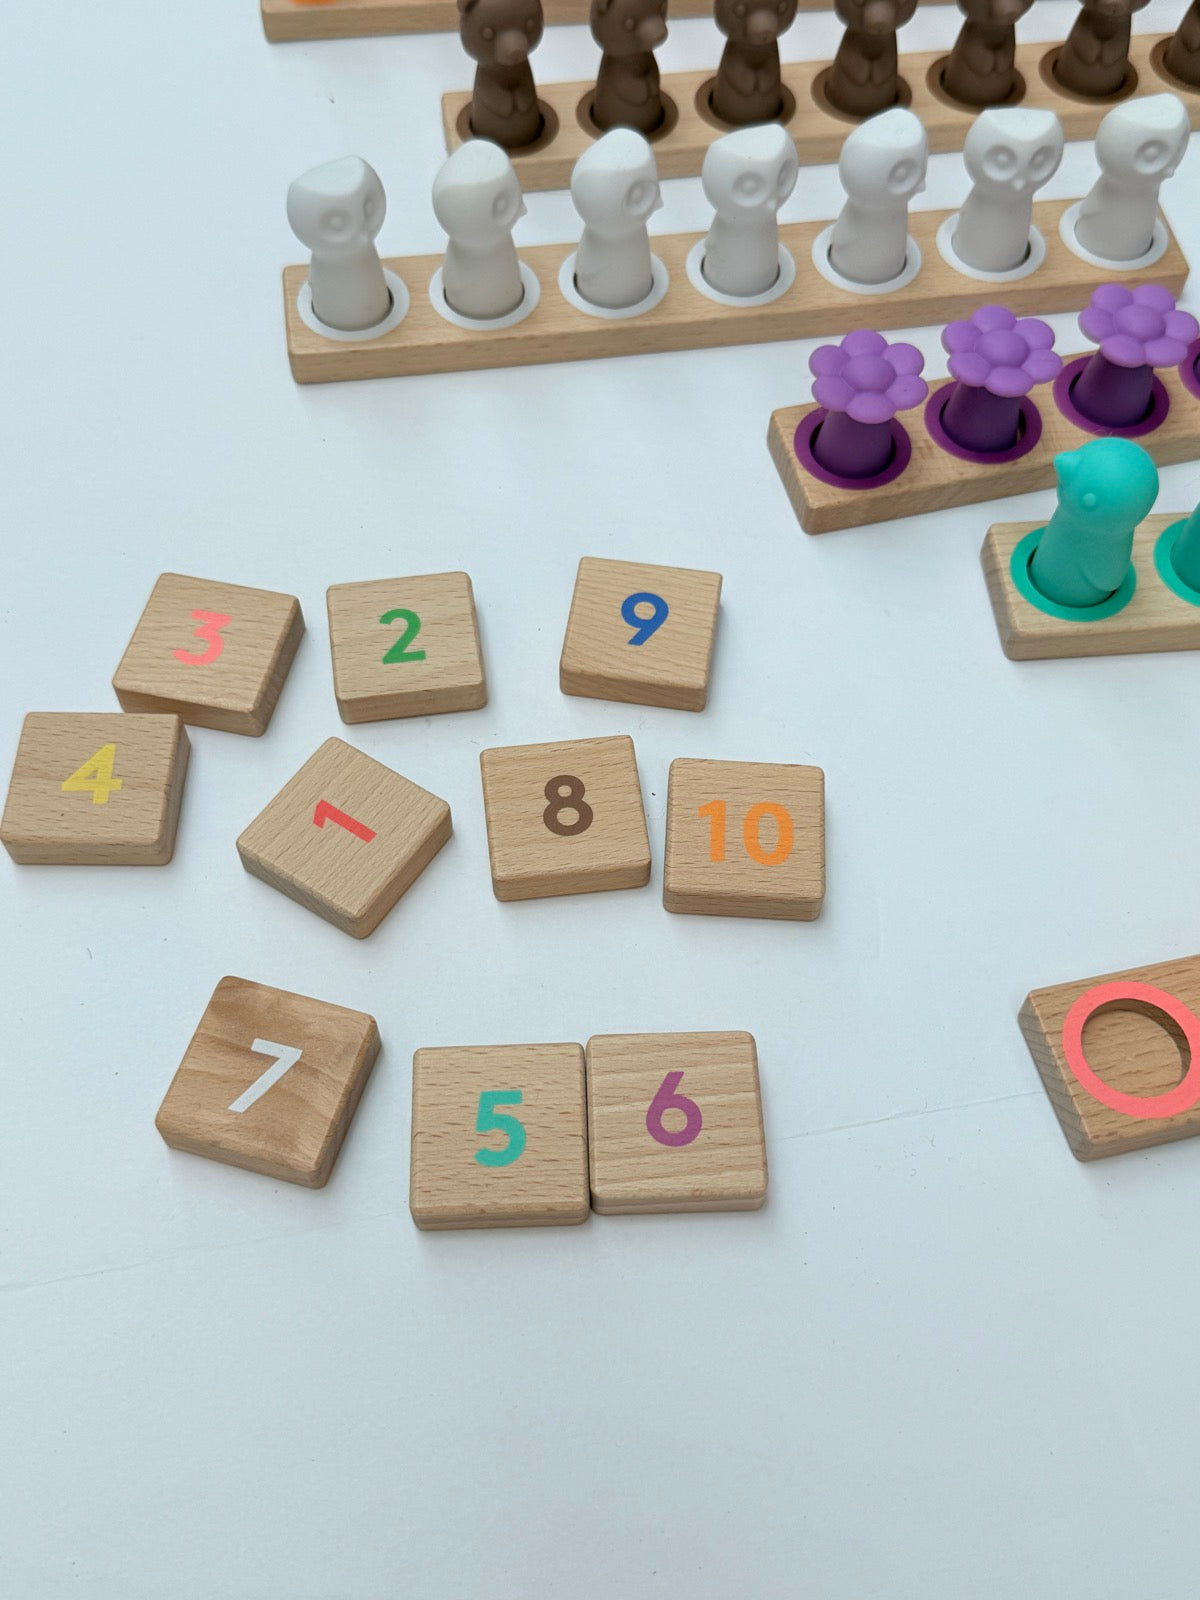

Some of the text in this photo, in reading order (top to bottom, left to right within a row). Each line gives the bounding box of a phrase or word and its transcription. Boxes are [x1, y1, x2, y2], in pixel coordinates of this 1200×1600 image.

[175, 610, 230, 664] 3
[379, 609, 426, 664] 2
[621, 592, 669, 646] 9
[62, 744, 122, 803] 4
[313, 800, 377, 843] 1
[538, 775, 593, 836] 8
[699, 801, 796, 865] 10
[228, 1038, 302, 1113] 7
[475, 1090, 526, 1167] 5
[646, 1072, 703, 1147] 6
